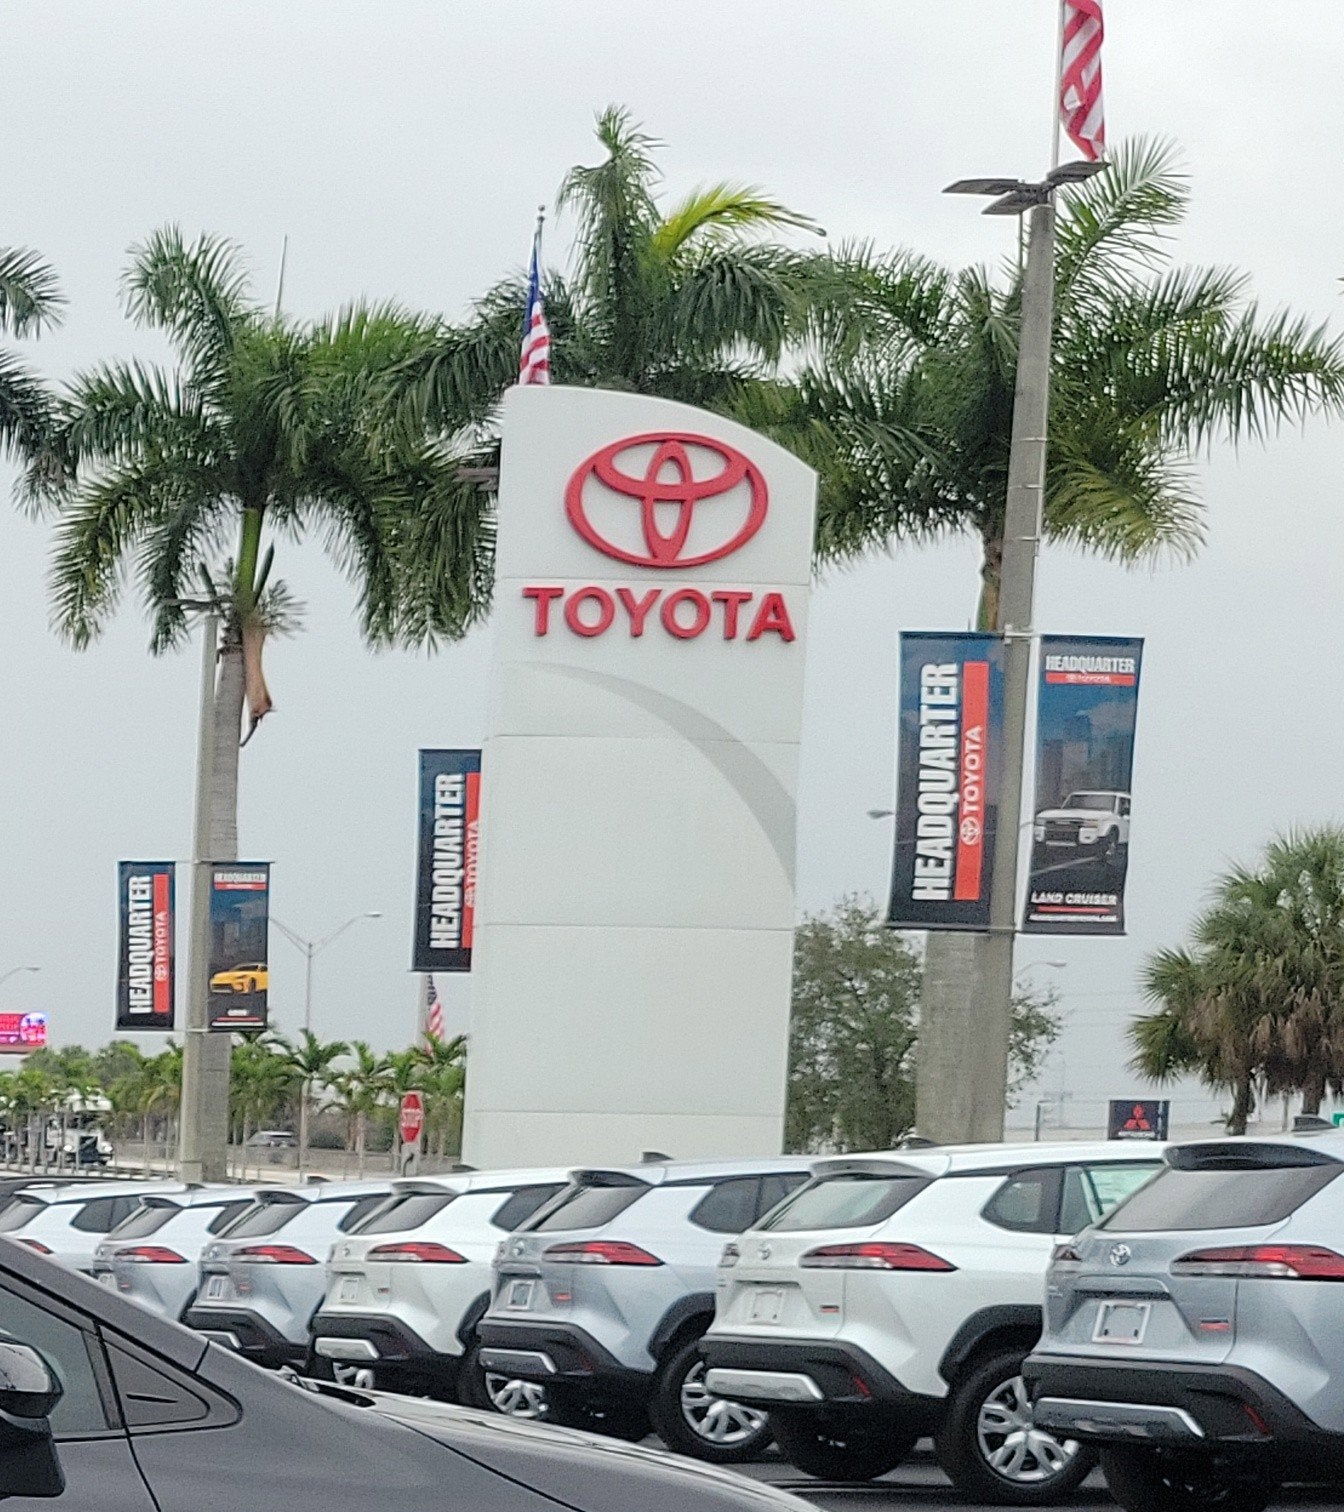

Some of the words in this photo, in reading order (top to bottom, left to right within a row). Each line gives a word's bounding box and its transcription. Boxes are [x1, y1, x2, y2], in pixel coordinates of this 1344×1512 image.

[523, 586, 796, 643] TOYOTA
[1045, 655, 1135, 674] HEADQUARTER
[912, 662, 960, 900] HEADQUARTER
[963, 725, 984, 811] TOYOTA
[430, 773, 465, 949] HEADQUARTER
[1031, 889, 1064, 904] LAND
[128, 875, 155, 1015] HEADQUARTER
[154, 911, 168, 964] TOYOTA
